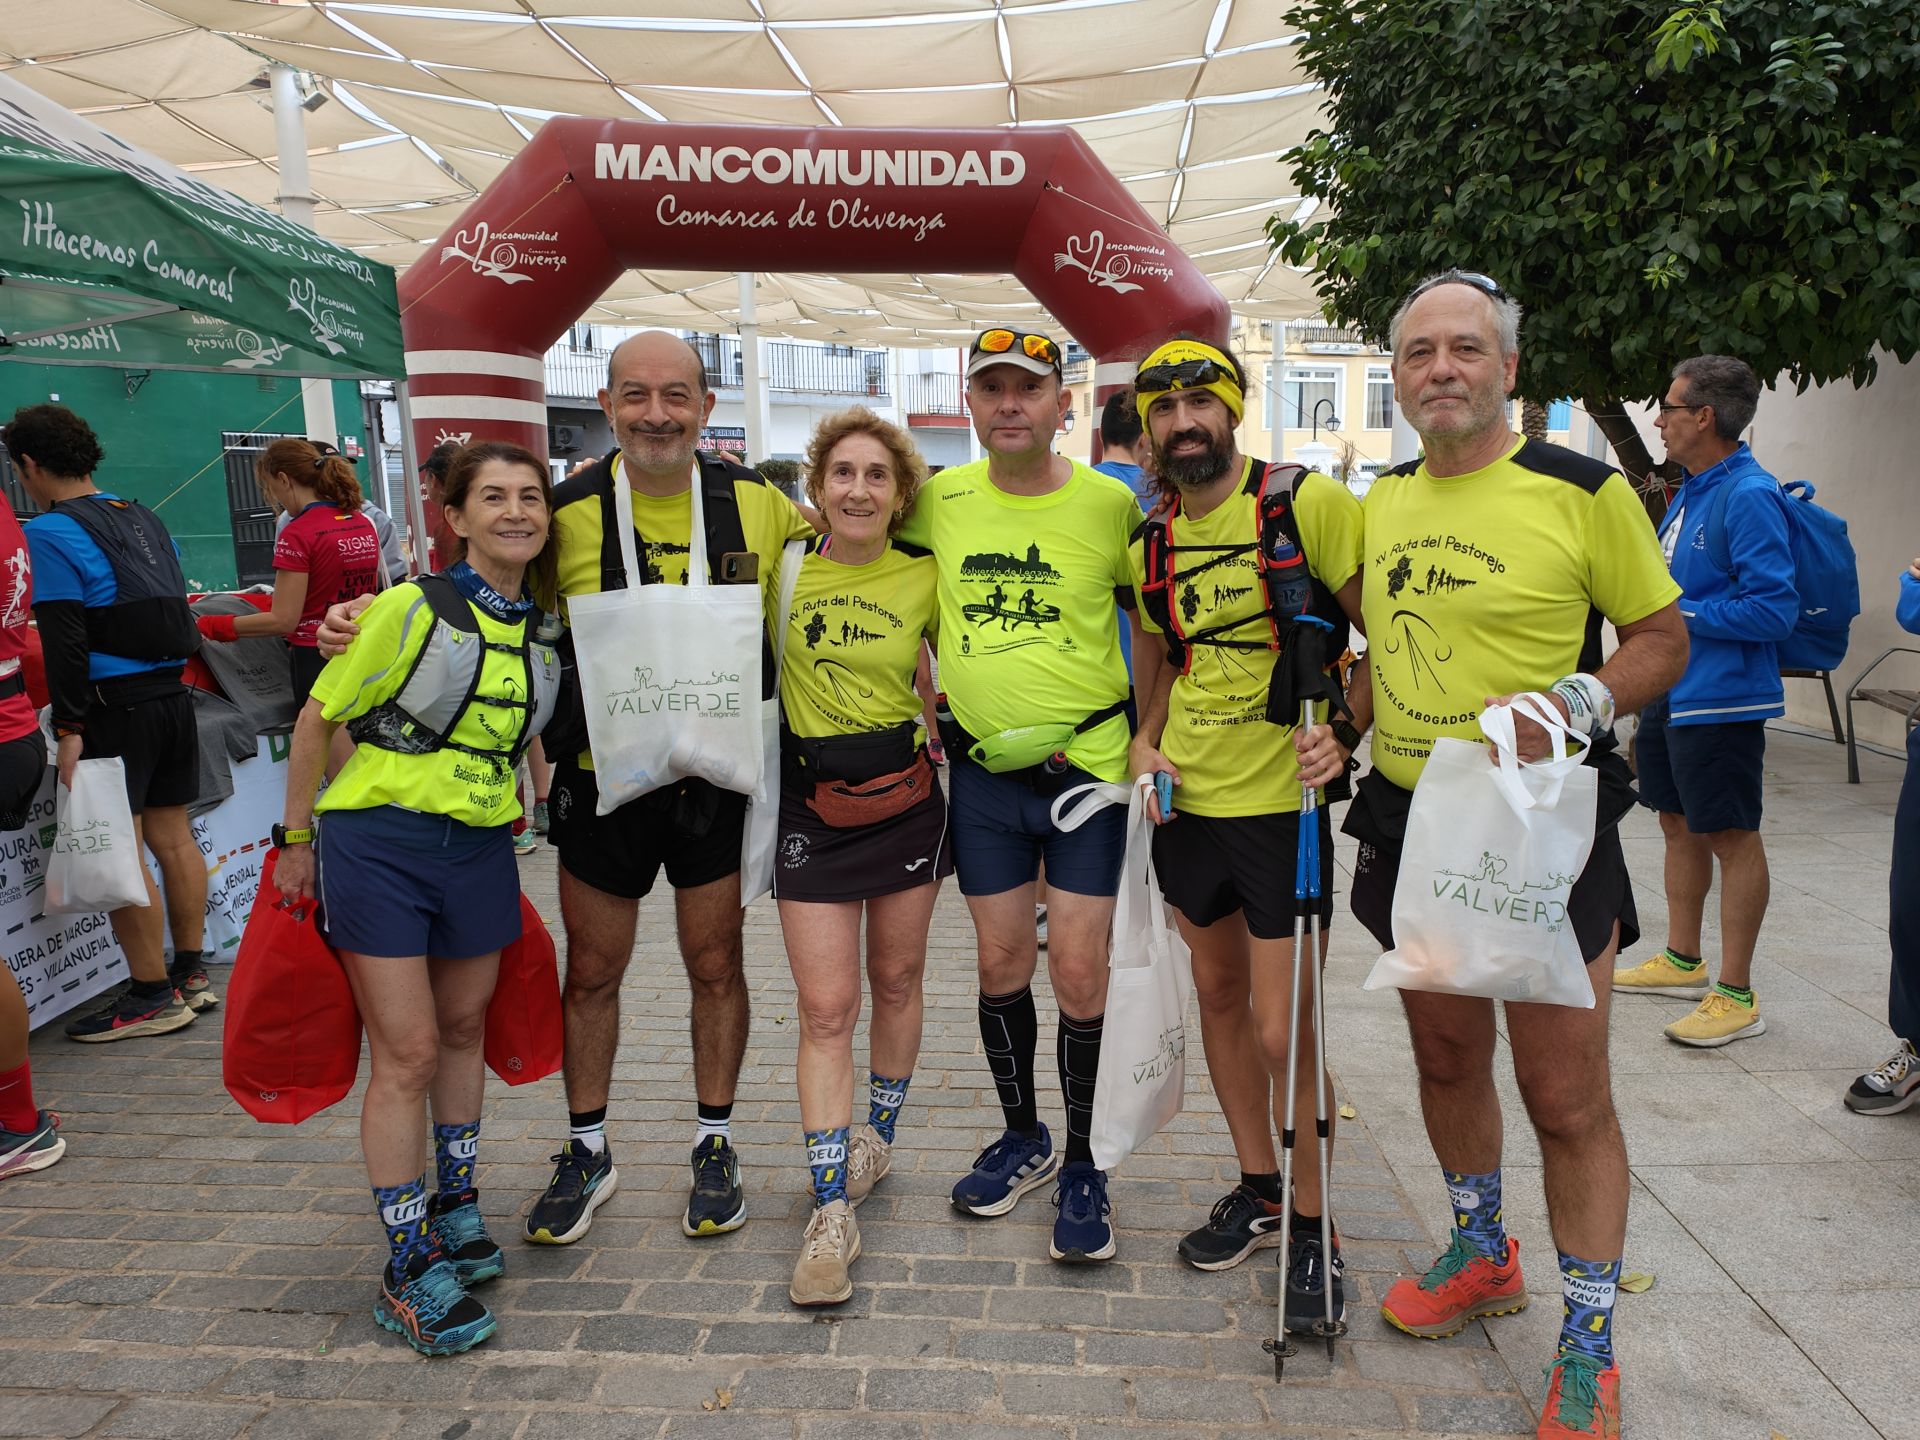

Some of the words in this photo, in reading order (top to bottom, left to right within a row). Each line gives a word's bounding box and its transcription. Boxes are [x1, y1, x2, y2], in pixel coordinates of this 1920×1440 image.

[594, 143, 1026, 186] MANCOMUNIDAD
[656, 194, 778, 229] Comarca
[788, 198, 817, 229] de
[827, 198, 946, 242] Olivenza
[143, 239, 237, 304] Comarca!
[717, 438, 745, 450] REYES
[942, 489, 965, 501] luanvi
[133, 524, 157, 565] EVADICT
[337, 535, 376, 552] STONE
[1375, 551, 1387, 568] XV
[1389, 539, 1418, 557] Ruta
[1421, 534, 1442, 548] del
[1444, 535, 1506, 574] Pestorejo
[961, 566, 1001, 577] Valverde
[1004, 567, 1016, 577] de
[802, 598, 828, 614] Ruta
[830, 594, 848, 606] del
[853, 595, 904, 629] Pestorejo
[606, 692, 741, 717] VALVERDE
[1375, 664, 1405, 711] PAJUELO
[1406, 708, 1477, 725] ABOGADOS
[698, 710, 709, 718] de
[1200, 717, 1240, 726] OCTUBRE
[1242, 712, 1265, 723] 2023
[1391, 745, 1431, 759] OCTUBR
[1397, 735, 1432, 745] VALVERDE
[1433, 879, 1566, 924] VALVERD
[46, 932, 63, 955] DE
[64, 911, 107, 945] VARGAS
[44, 935, 111, 981] VILLANUEVA
[1563, 1276, 1611, 1294] MANOLO
[1571, 1291, 1601, 1306] CAVA
